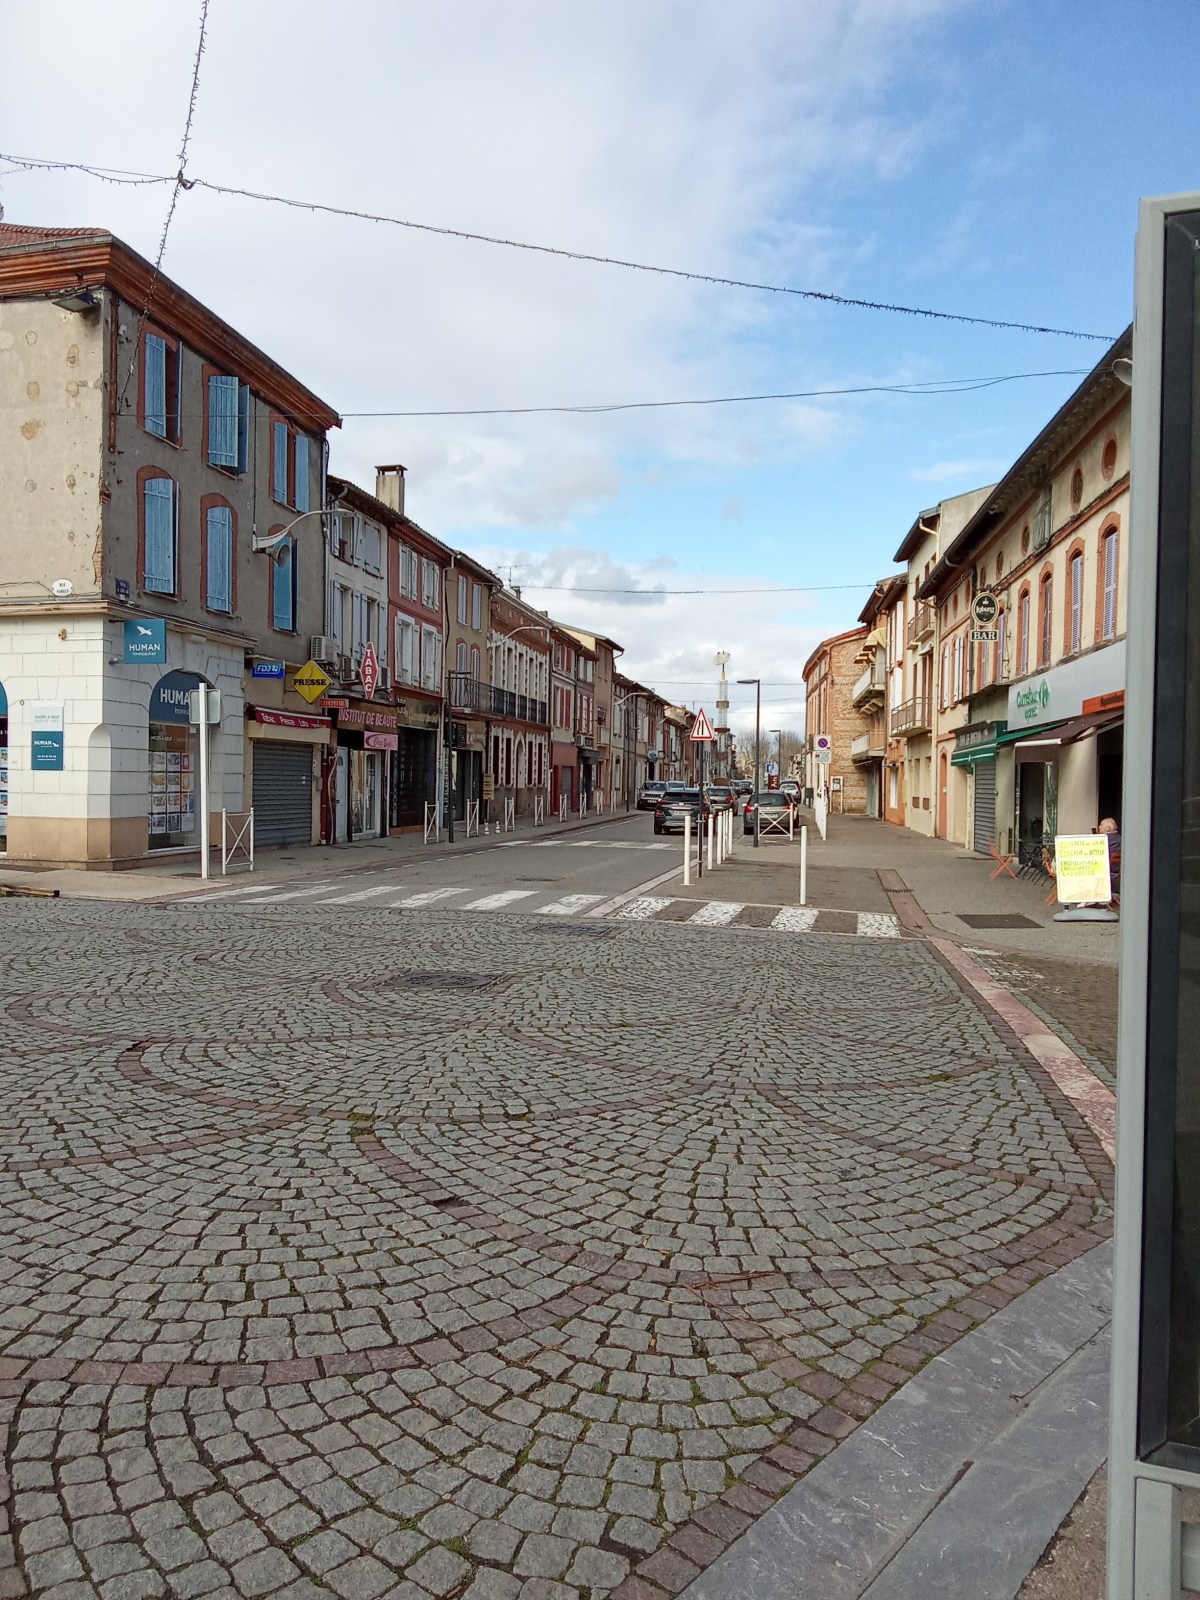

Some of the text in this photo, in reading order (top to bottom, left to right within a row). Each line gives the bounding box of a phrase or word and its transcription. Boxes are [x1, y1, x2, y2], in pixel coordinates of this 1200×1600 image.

[974, 631, 995, 640] BAR
[129, 643, 160, 651] HUMAN
[293, 678, 327, 686] PRESSE
[338, 707, 366, 723] INSTITUT
[366, 712, 375, 725] DE
